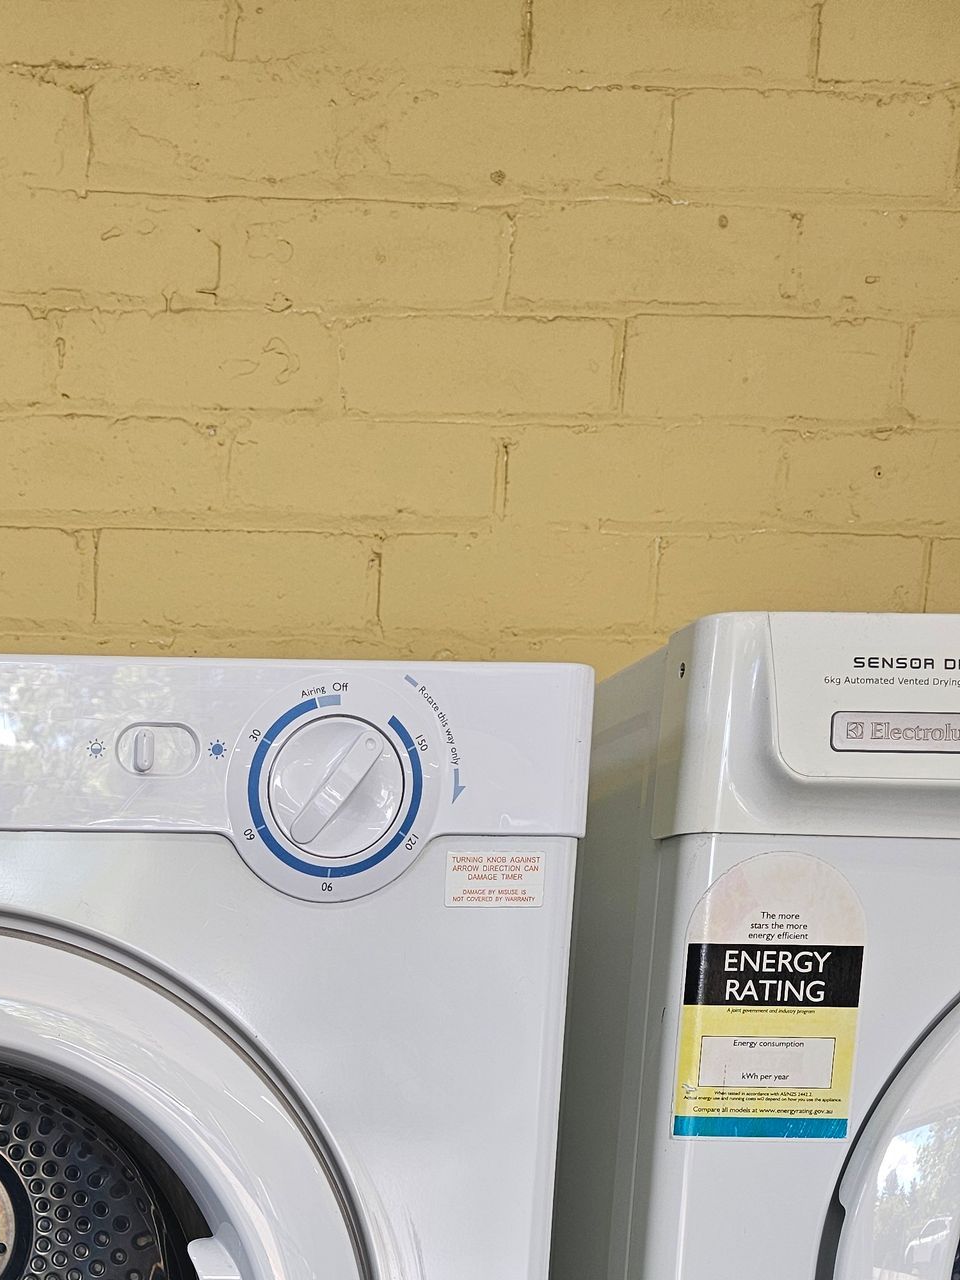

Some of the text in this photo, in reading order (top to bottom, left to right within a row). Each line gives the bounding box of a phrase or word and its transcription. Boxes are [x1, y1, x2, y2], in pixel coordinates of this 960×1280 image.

[853, 657, 960, 669] SENSOR D
[824, 676, 840, 685] 6kg
[844, 676, 894, 685] Automated
[898, 677, 930, 685] Vented
[301, 682, 348, 698] Airing Off
[418, 686, 460, 765] Rotate this way only
[249, 728, 262, 742] 30
[415, 734, 428, 751] 150
[243, 828, 256, 842] 60
[405, 834, 419, 851] 120
[510, 856, 540, 864] AGAINST
[750, 922, 769, 930] stars
[771, 922, 784, 930] the
[748, 932, 808, 941] energy efficient
[724, 950, 832, 973] ENERGY
[725, 980, 825, 1002] RATING
[733, 1040, 804, 1048] Energy consumption
[741, 1072, 758, 1080] kWh
[692, 1106, 720, 1114] Compare
